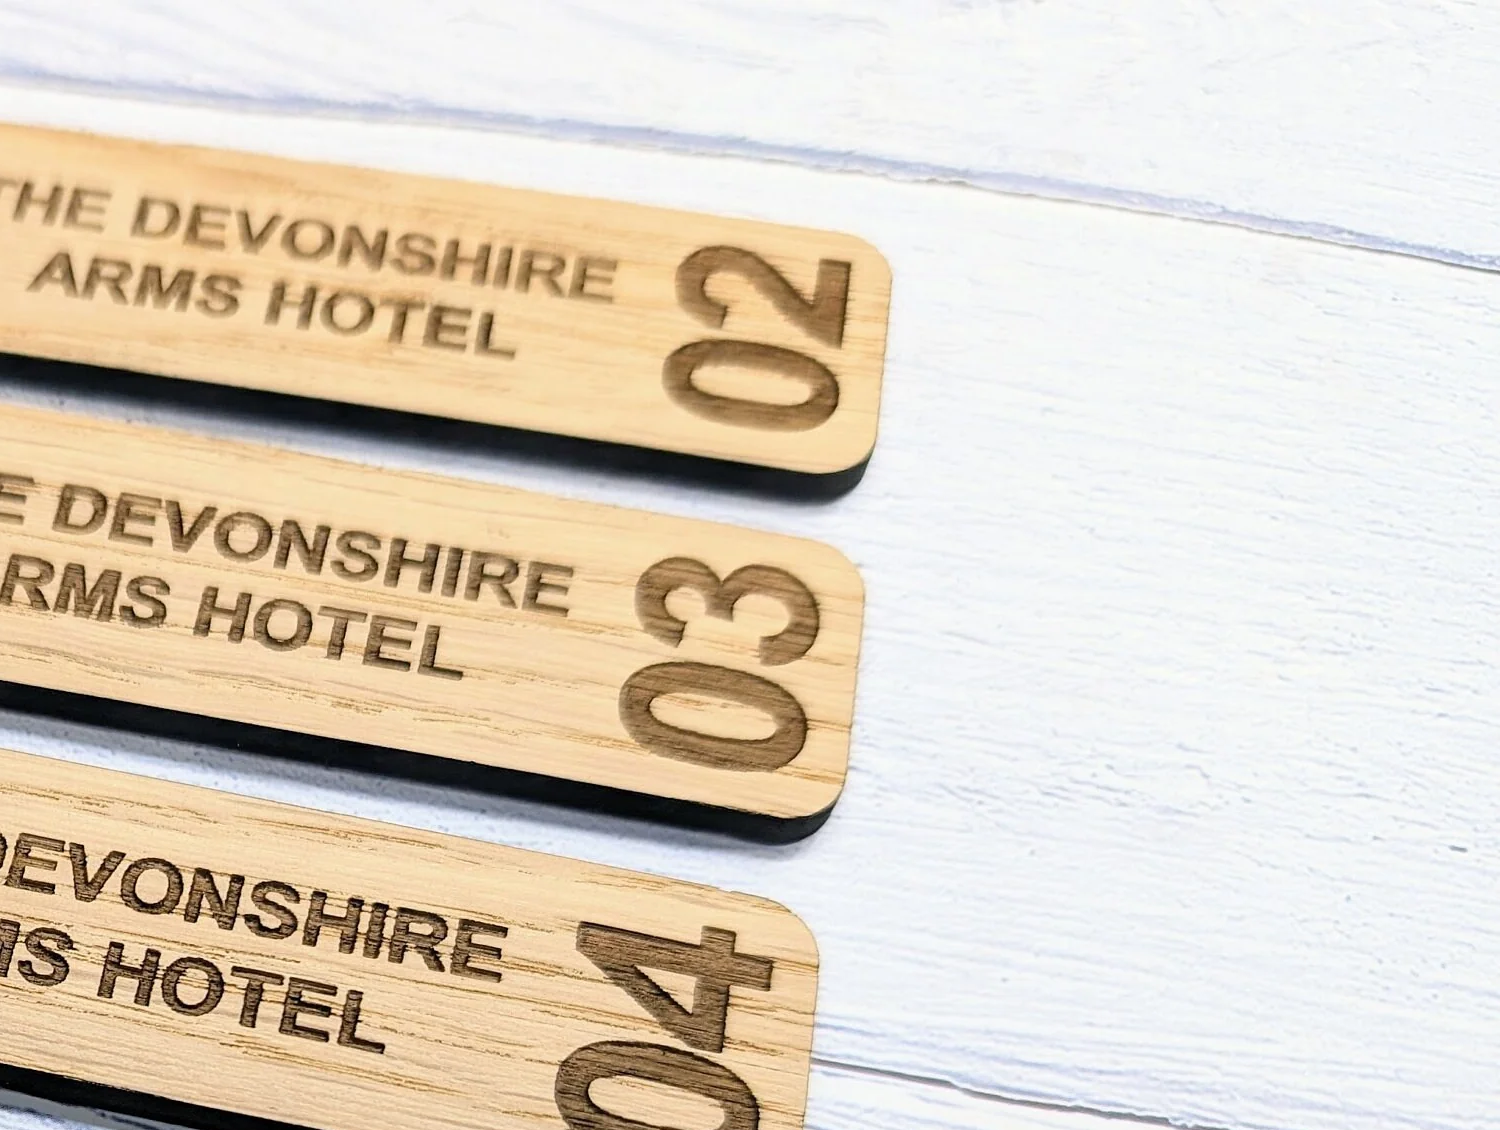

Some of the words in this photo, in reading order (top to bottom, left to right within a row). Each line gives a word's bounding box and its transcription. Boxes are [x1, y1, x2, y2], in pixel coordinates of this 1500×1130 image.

[27, 252, 244, 317] ARMS
[264, 284, 519, 360] HOTEL
[130, 196, 621, 303] DEVONSHIRE
[661, 243, 851, 433] 02
[50, 483, 574, 617] DEVONSHIRE
[191, 585, 466, 680] HOTEL
[617, 555, 819, 773] 03
[97, 941, 389, 1055] HOTEL
